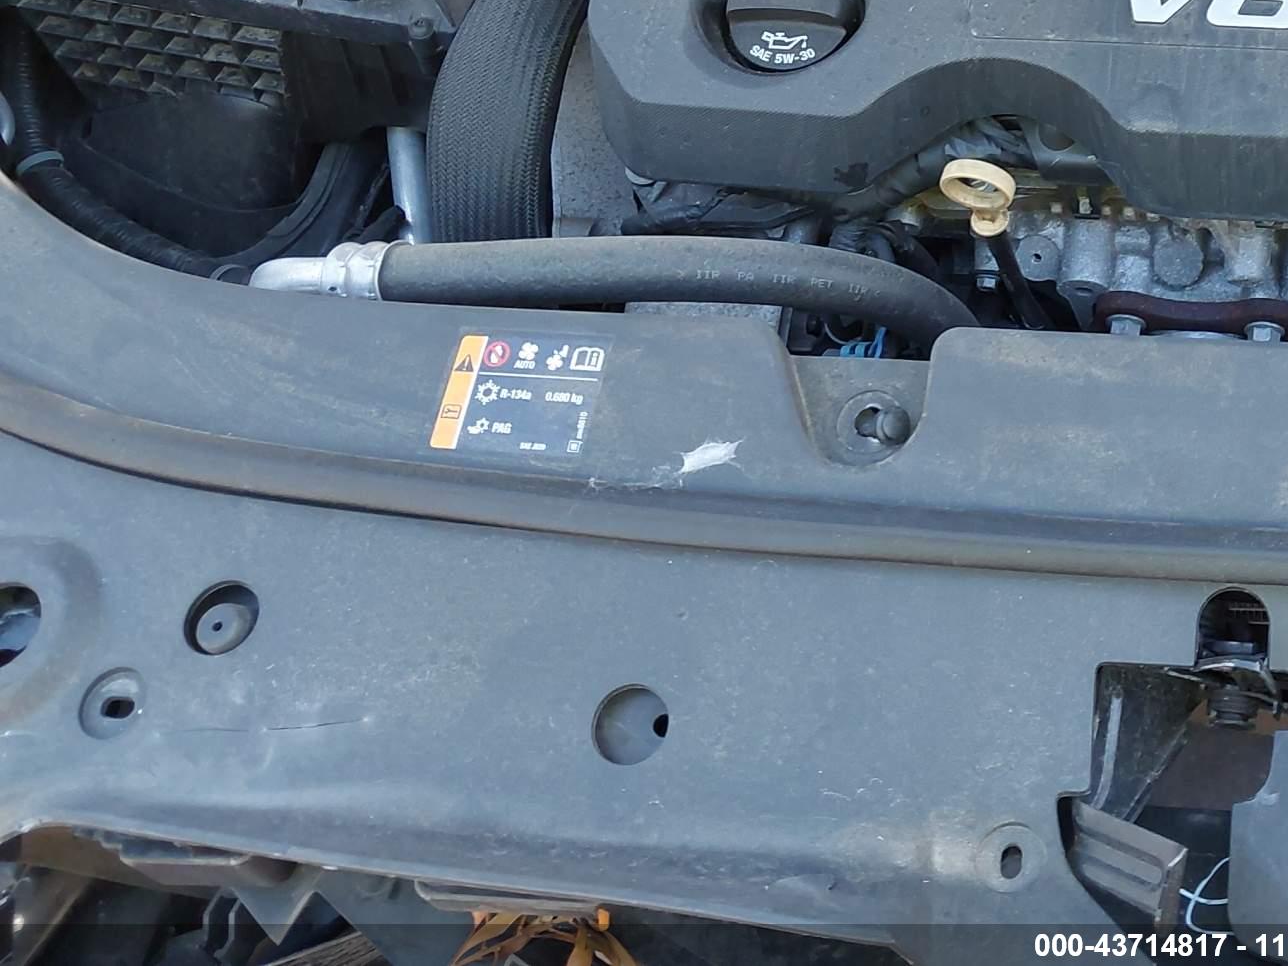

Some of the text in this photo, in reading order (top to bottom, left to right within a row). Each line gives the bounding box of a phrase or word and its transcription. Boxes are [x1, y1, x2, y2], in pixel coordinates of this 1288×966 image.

[750, 45, 815, 64] SAE 5W-30
[737, 270, 754, 280] PA
[513, 360, 536, 369] AUTO
[499, 388, 532, 401] R-134a
[571, 393, 583, 405] kg
[491, 422, 512, 434] PAG
